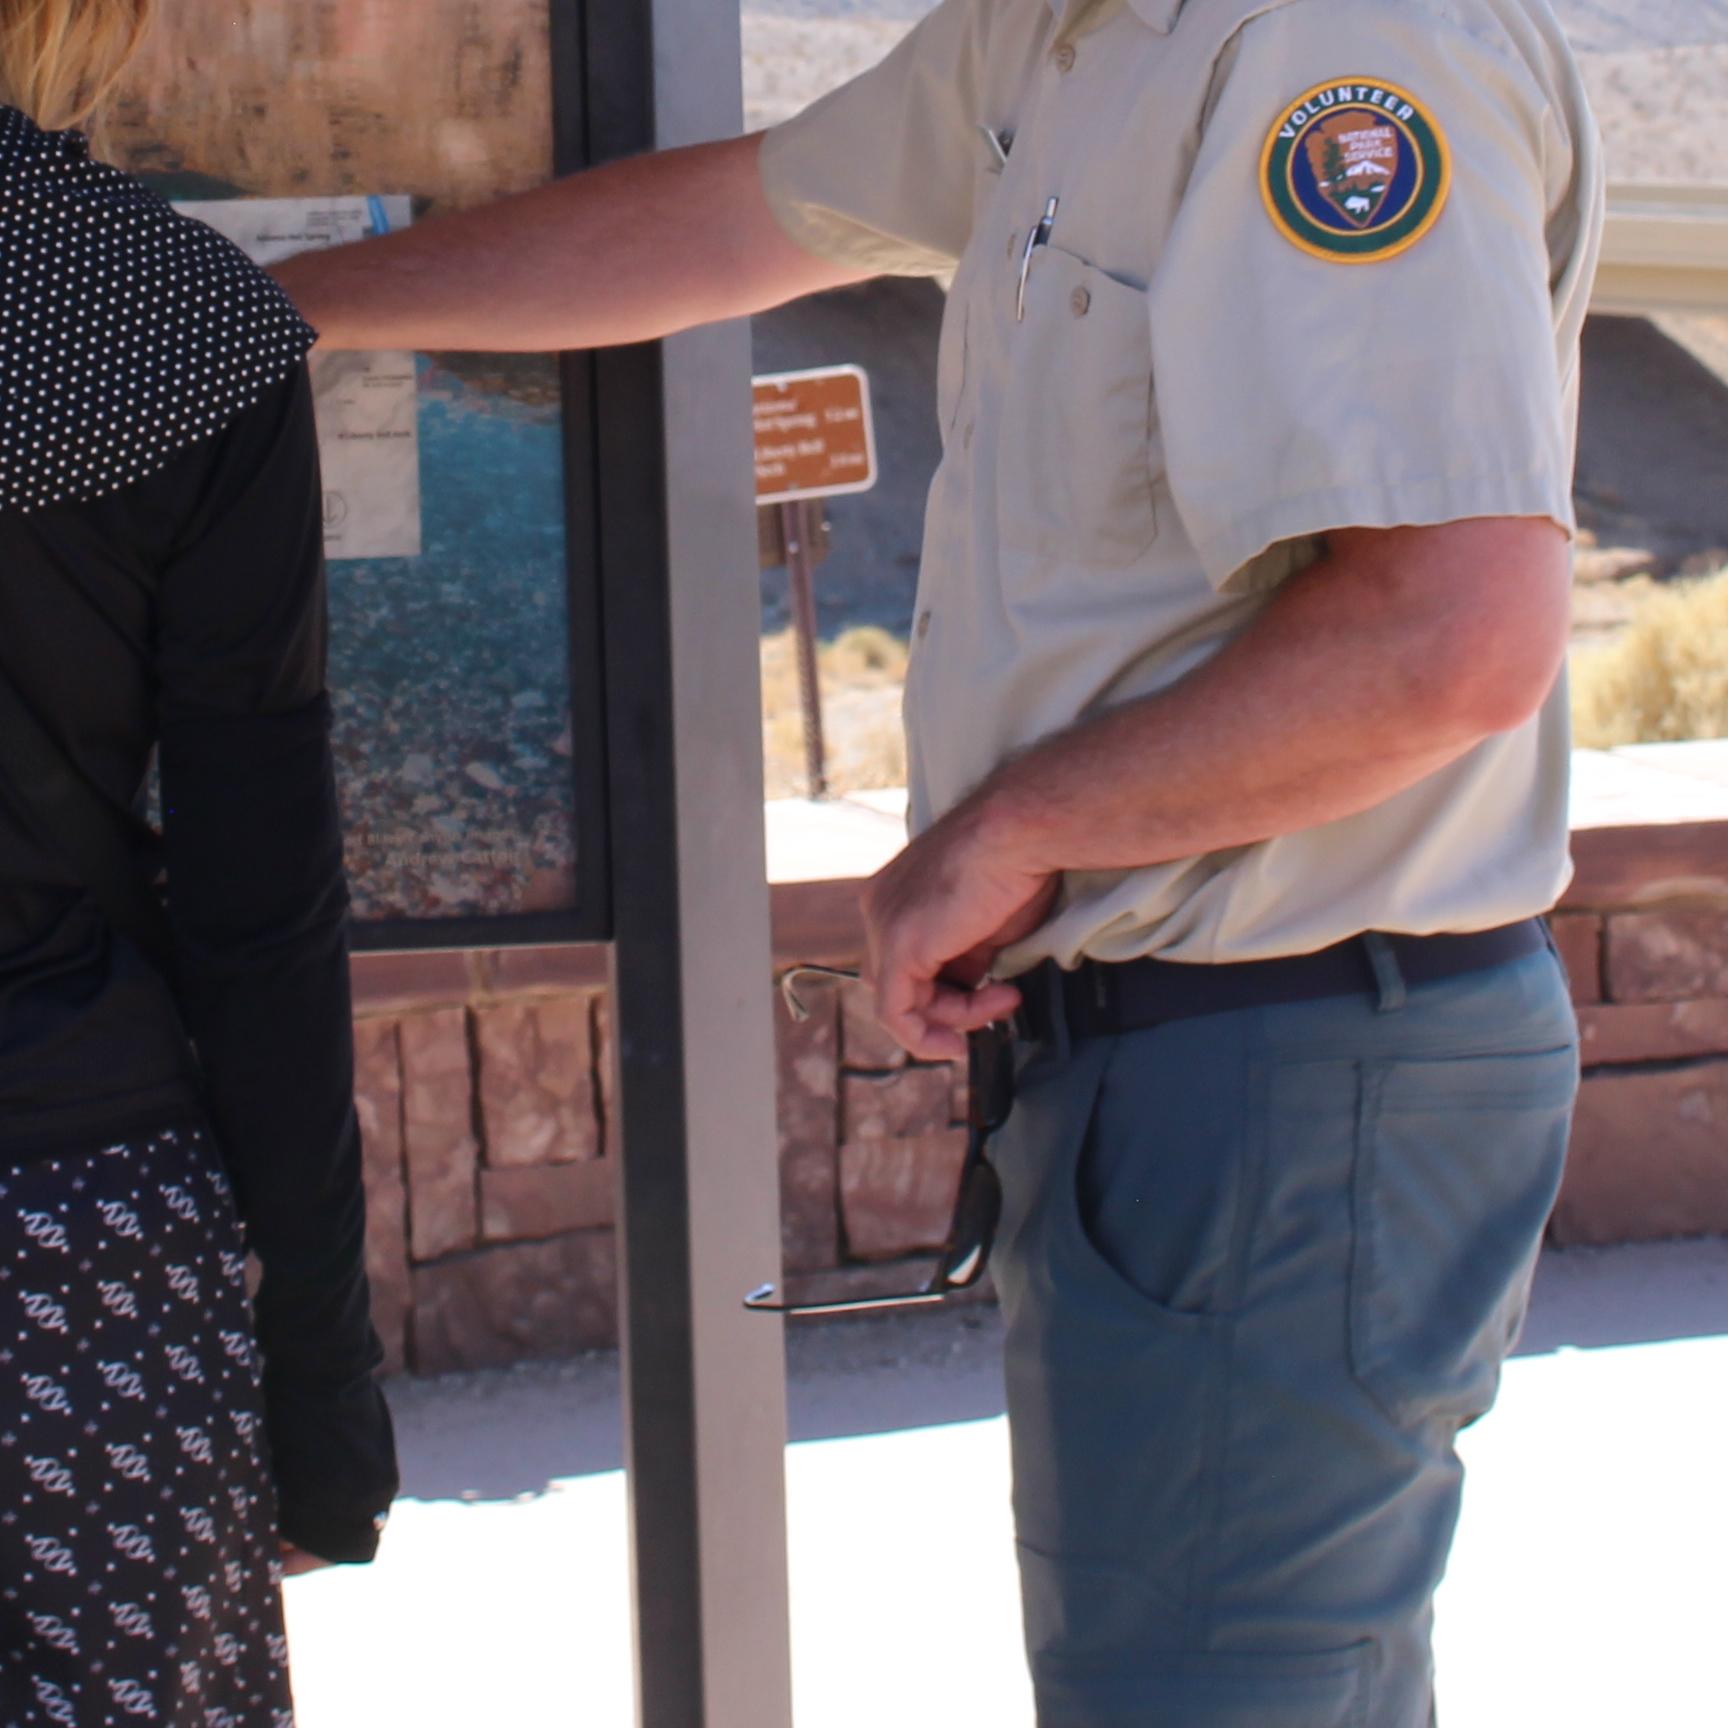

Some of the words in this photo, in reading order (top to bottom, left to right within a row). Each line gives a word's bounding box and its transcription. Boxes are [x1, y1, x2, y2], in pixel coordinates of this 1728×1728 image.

[1279, 86, 1414, 139] VOLUNTEER
[1338, 126, 1392, 143] NATIONAL
[1349, 138, 1382, 152] PARK
[1343, 146, 1394, 163] SERVICE
